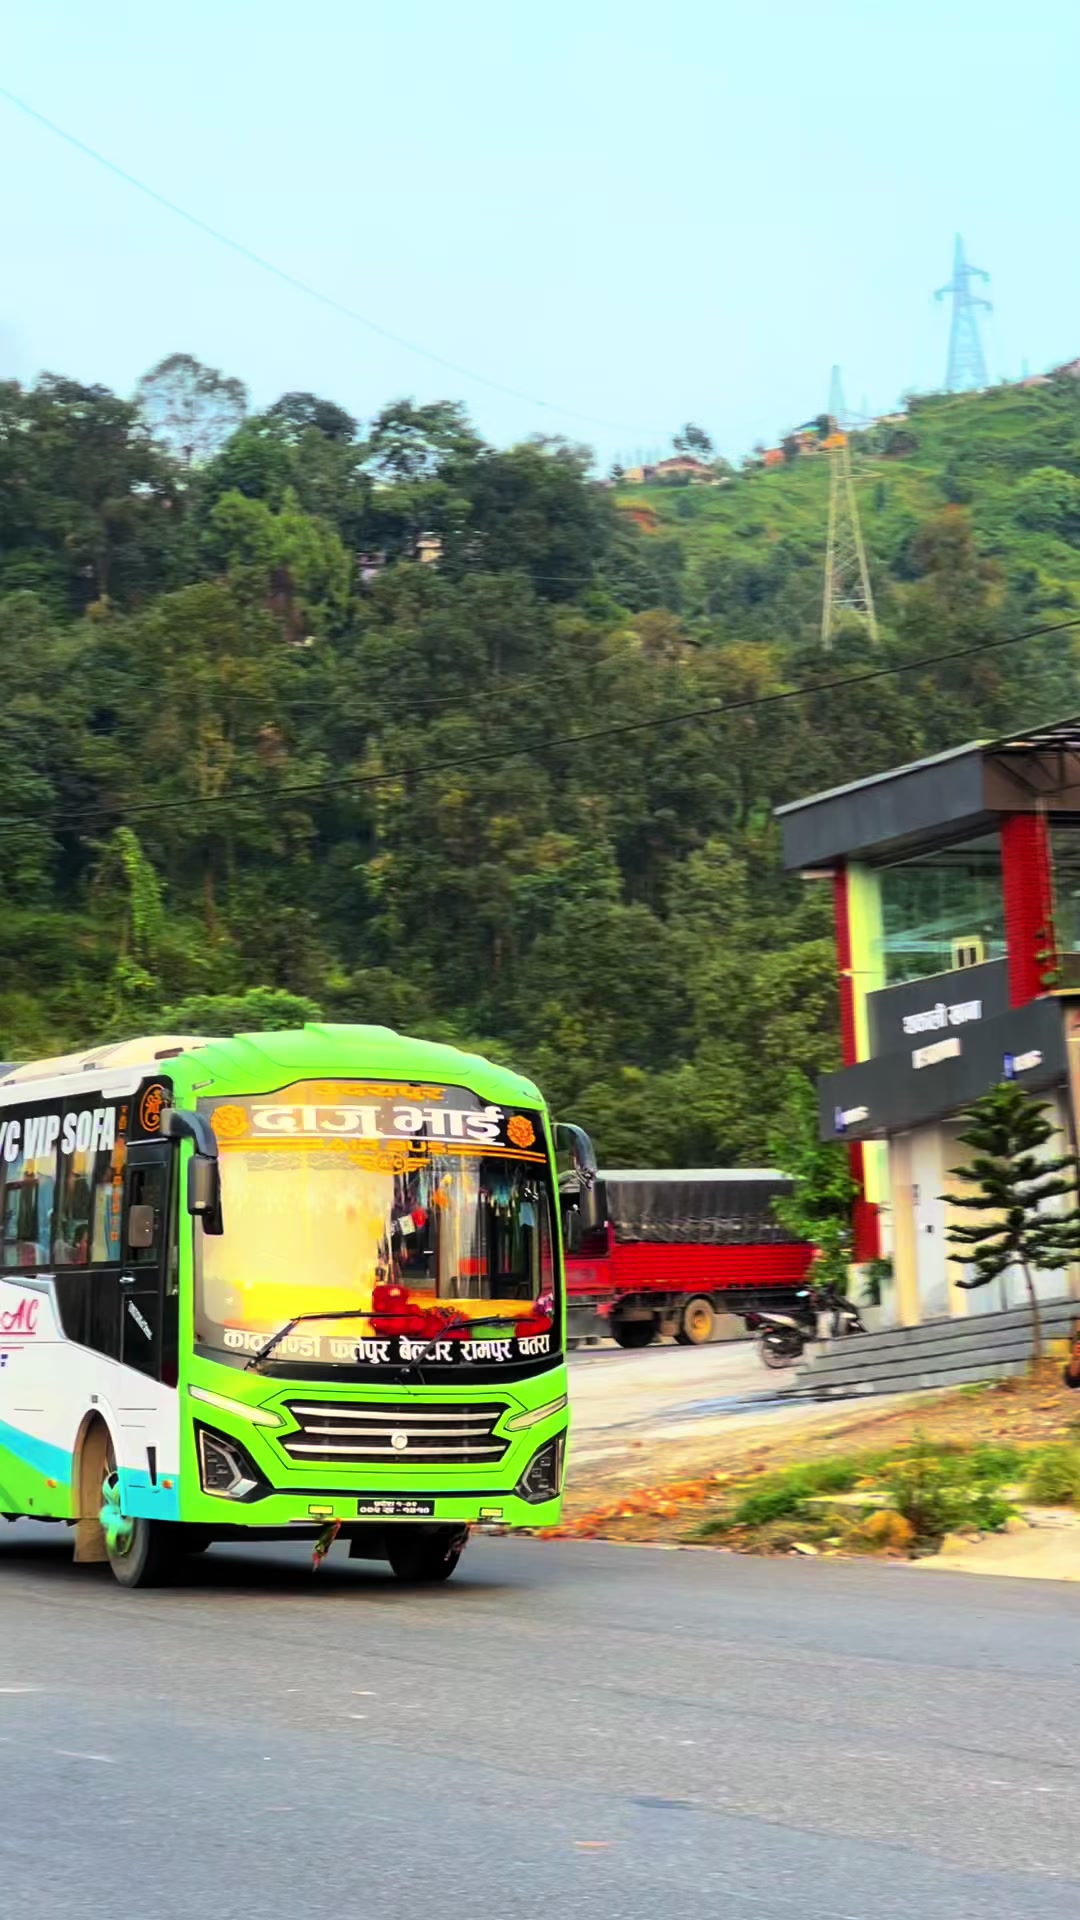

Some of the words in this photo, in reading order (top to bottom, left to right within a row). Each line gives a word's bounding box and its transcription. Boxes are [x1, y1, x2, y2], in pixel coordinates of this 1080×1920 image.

[23, 1115, 61, 1160] VIP
[61, 1107, 116, 1154] SOFA
[393, 1106, 504, 1142] भाई
[329, 1138, 379, 1152] AIR
[386, 1139, 446, 1155] BUS
[460, 1338, 512, 1361] रामपुर
[517, 1335, 550, 1355] चतरा
